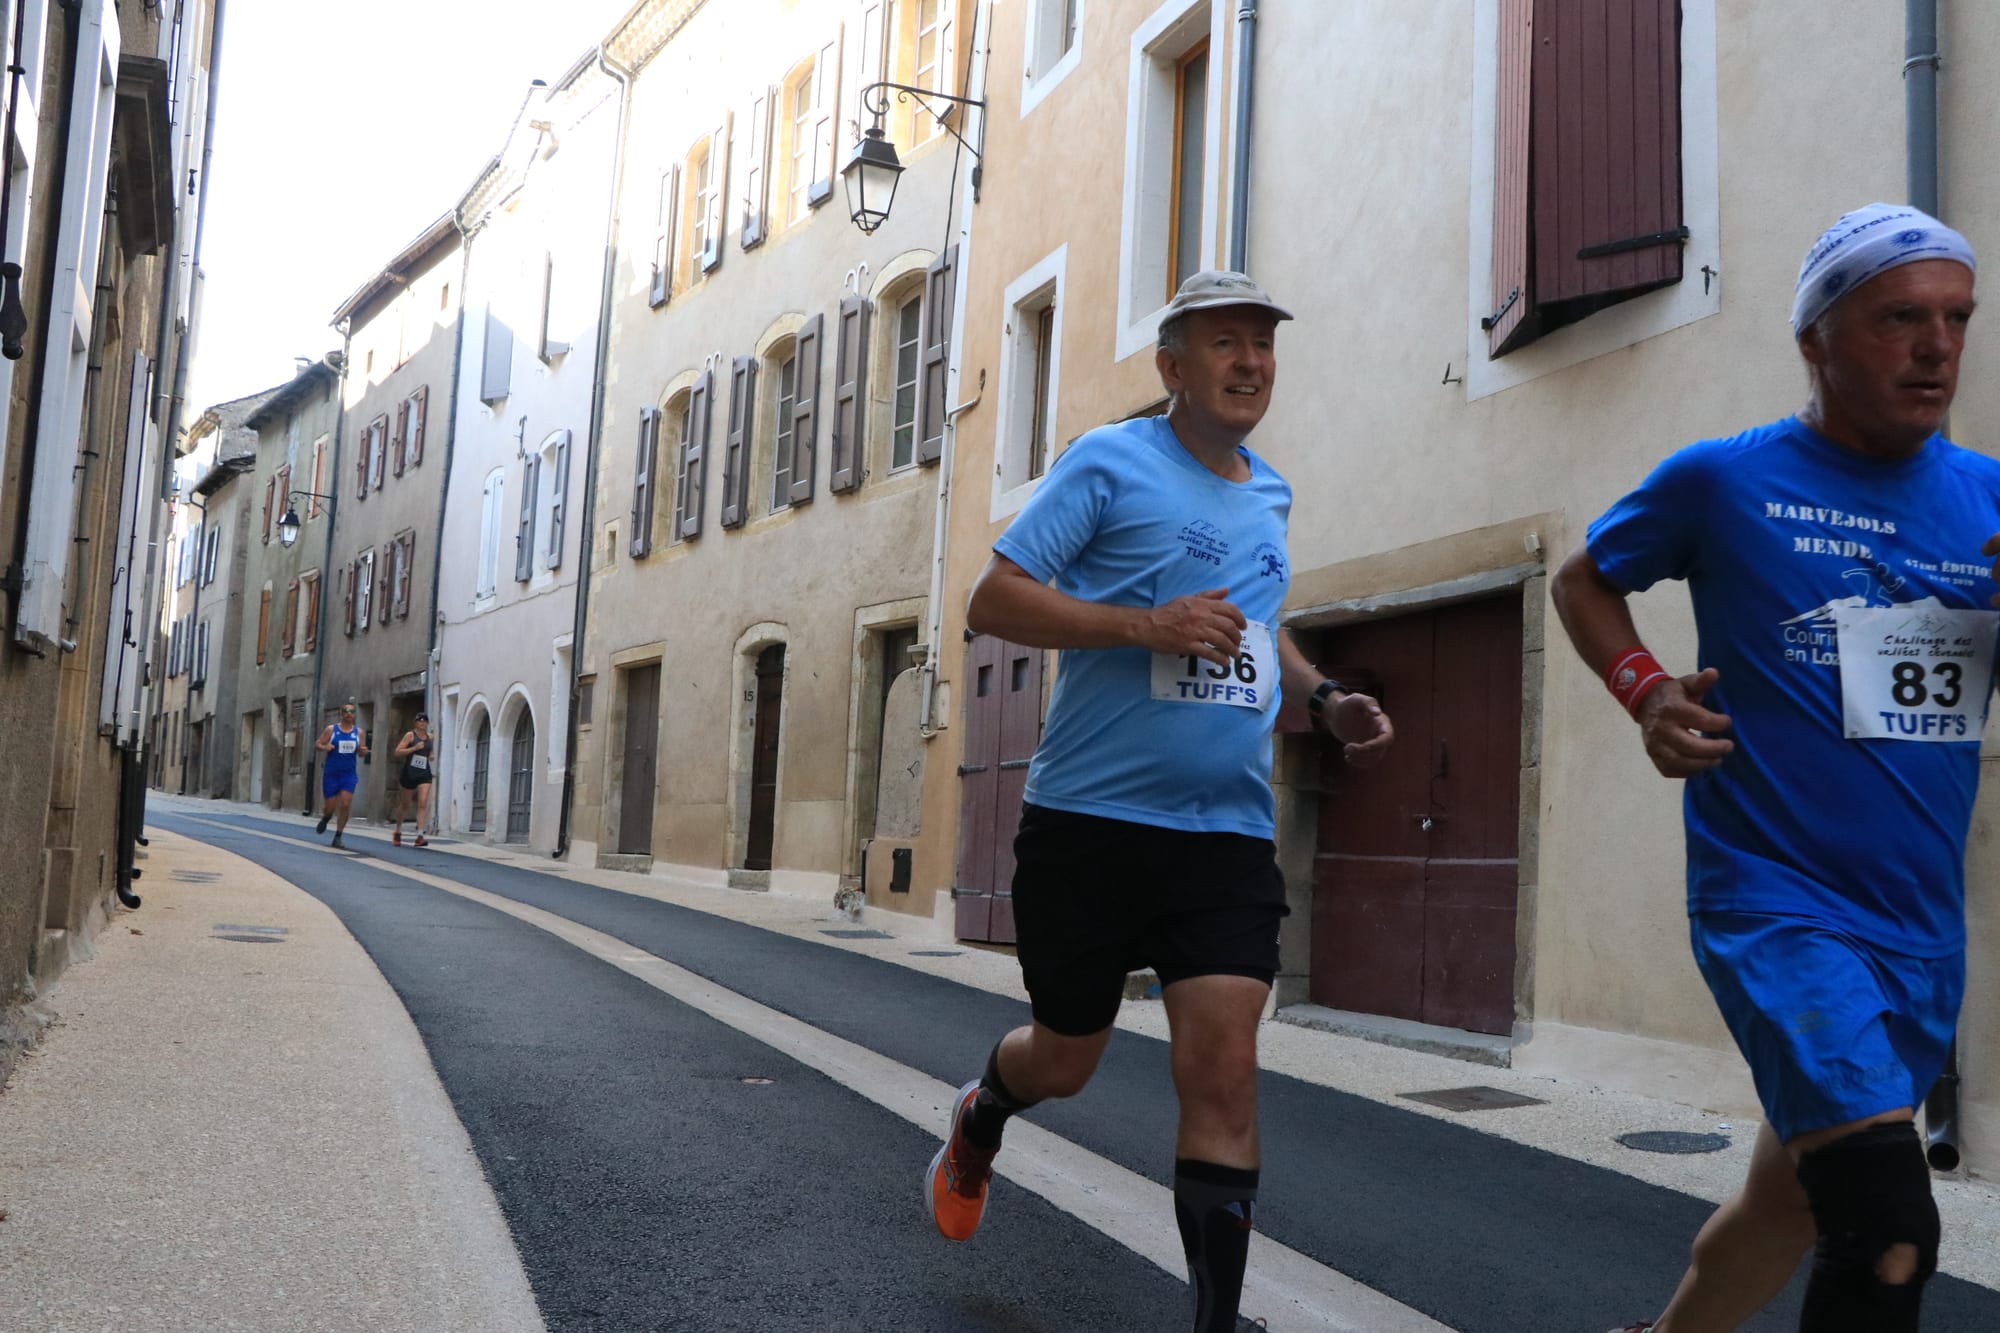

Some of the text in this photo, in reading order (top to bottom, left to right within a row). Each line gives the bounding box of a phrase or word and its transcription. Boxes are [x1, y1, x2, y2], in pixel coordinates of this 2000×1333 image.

[1765, 502, 1897, 534] MARVEJOLS
[1186, 546, 1221, 565] TUFF'S
[1793, 537, 1873, 559] MENDE
[1884, 635, 1973, 648] Challenge des
[1784, 648, 1807, 662] en
[1878, 647, 1921, 657] vallées
[1176, 681, 1258, 704] TUFF'S
[1892, 661, 1963, 708] 83
[744, 690, 754, 702] 15
[1879, 711, 1967, 736] TUFF'S
